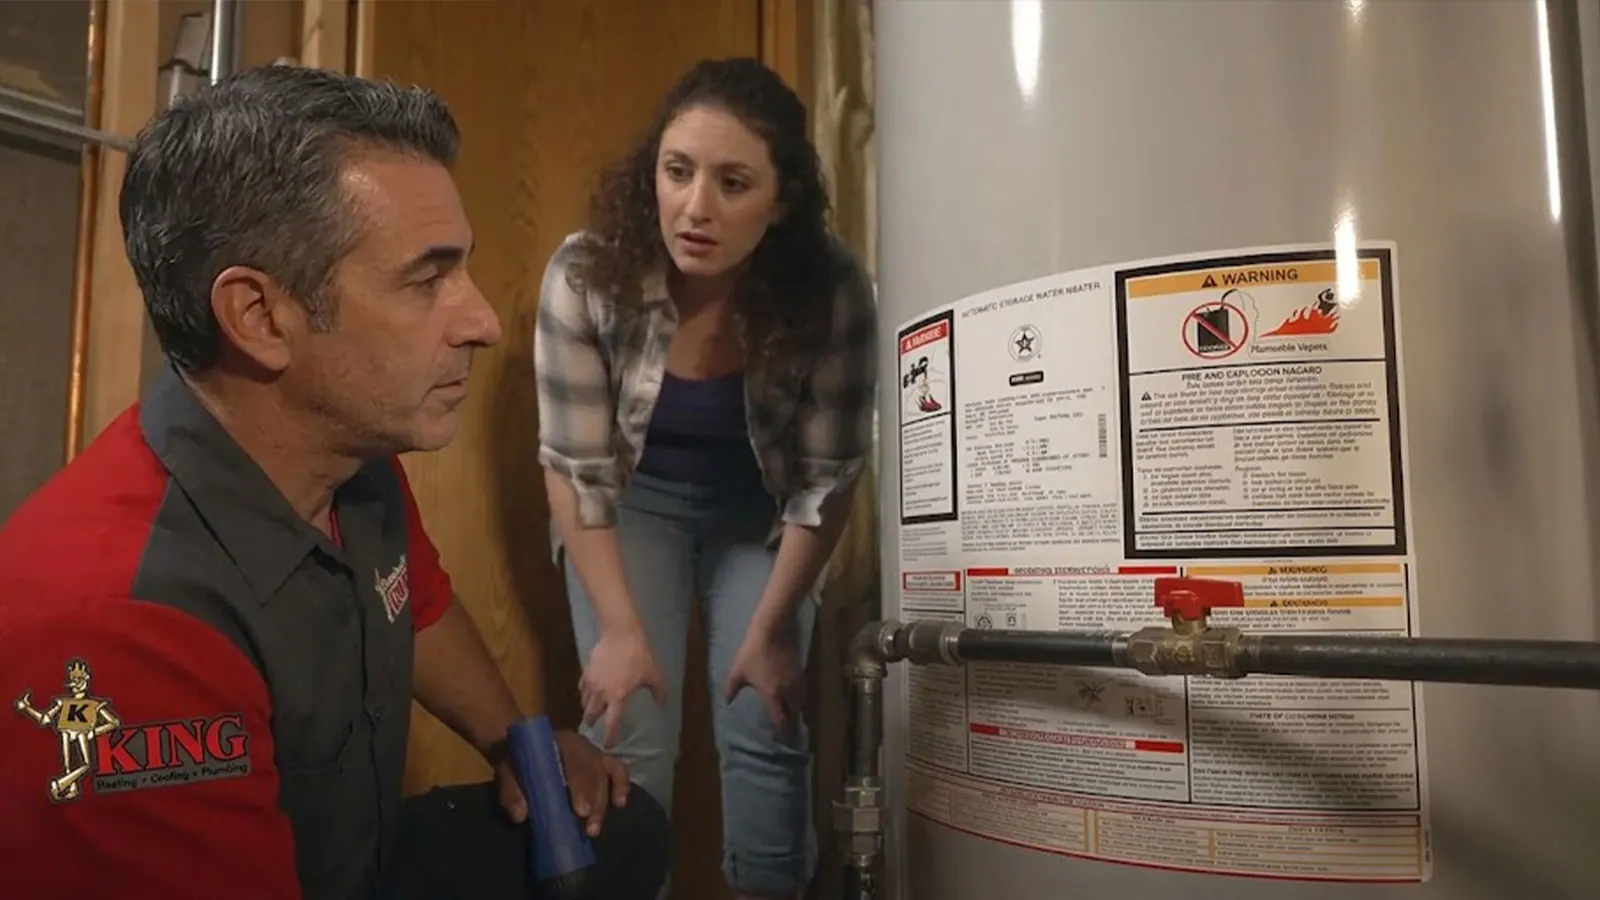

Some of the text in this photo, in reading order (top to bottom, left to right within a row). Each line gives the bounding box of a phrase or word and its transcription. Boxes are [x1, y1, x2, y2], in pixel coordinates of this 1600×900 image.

[1221, 268, 1299, 286] WARNING
[67, 703, 89, 724] K
[96, 715, 248, 775] KING
